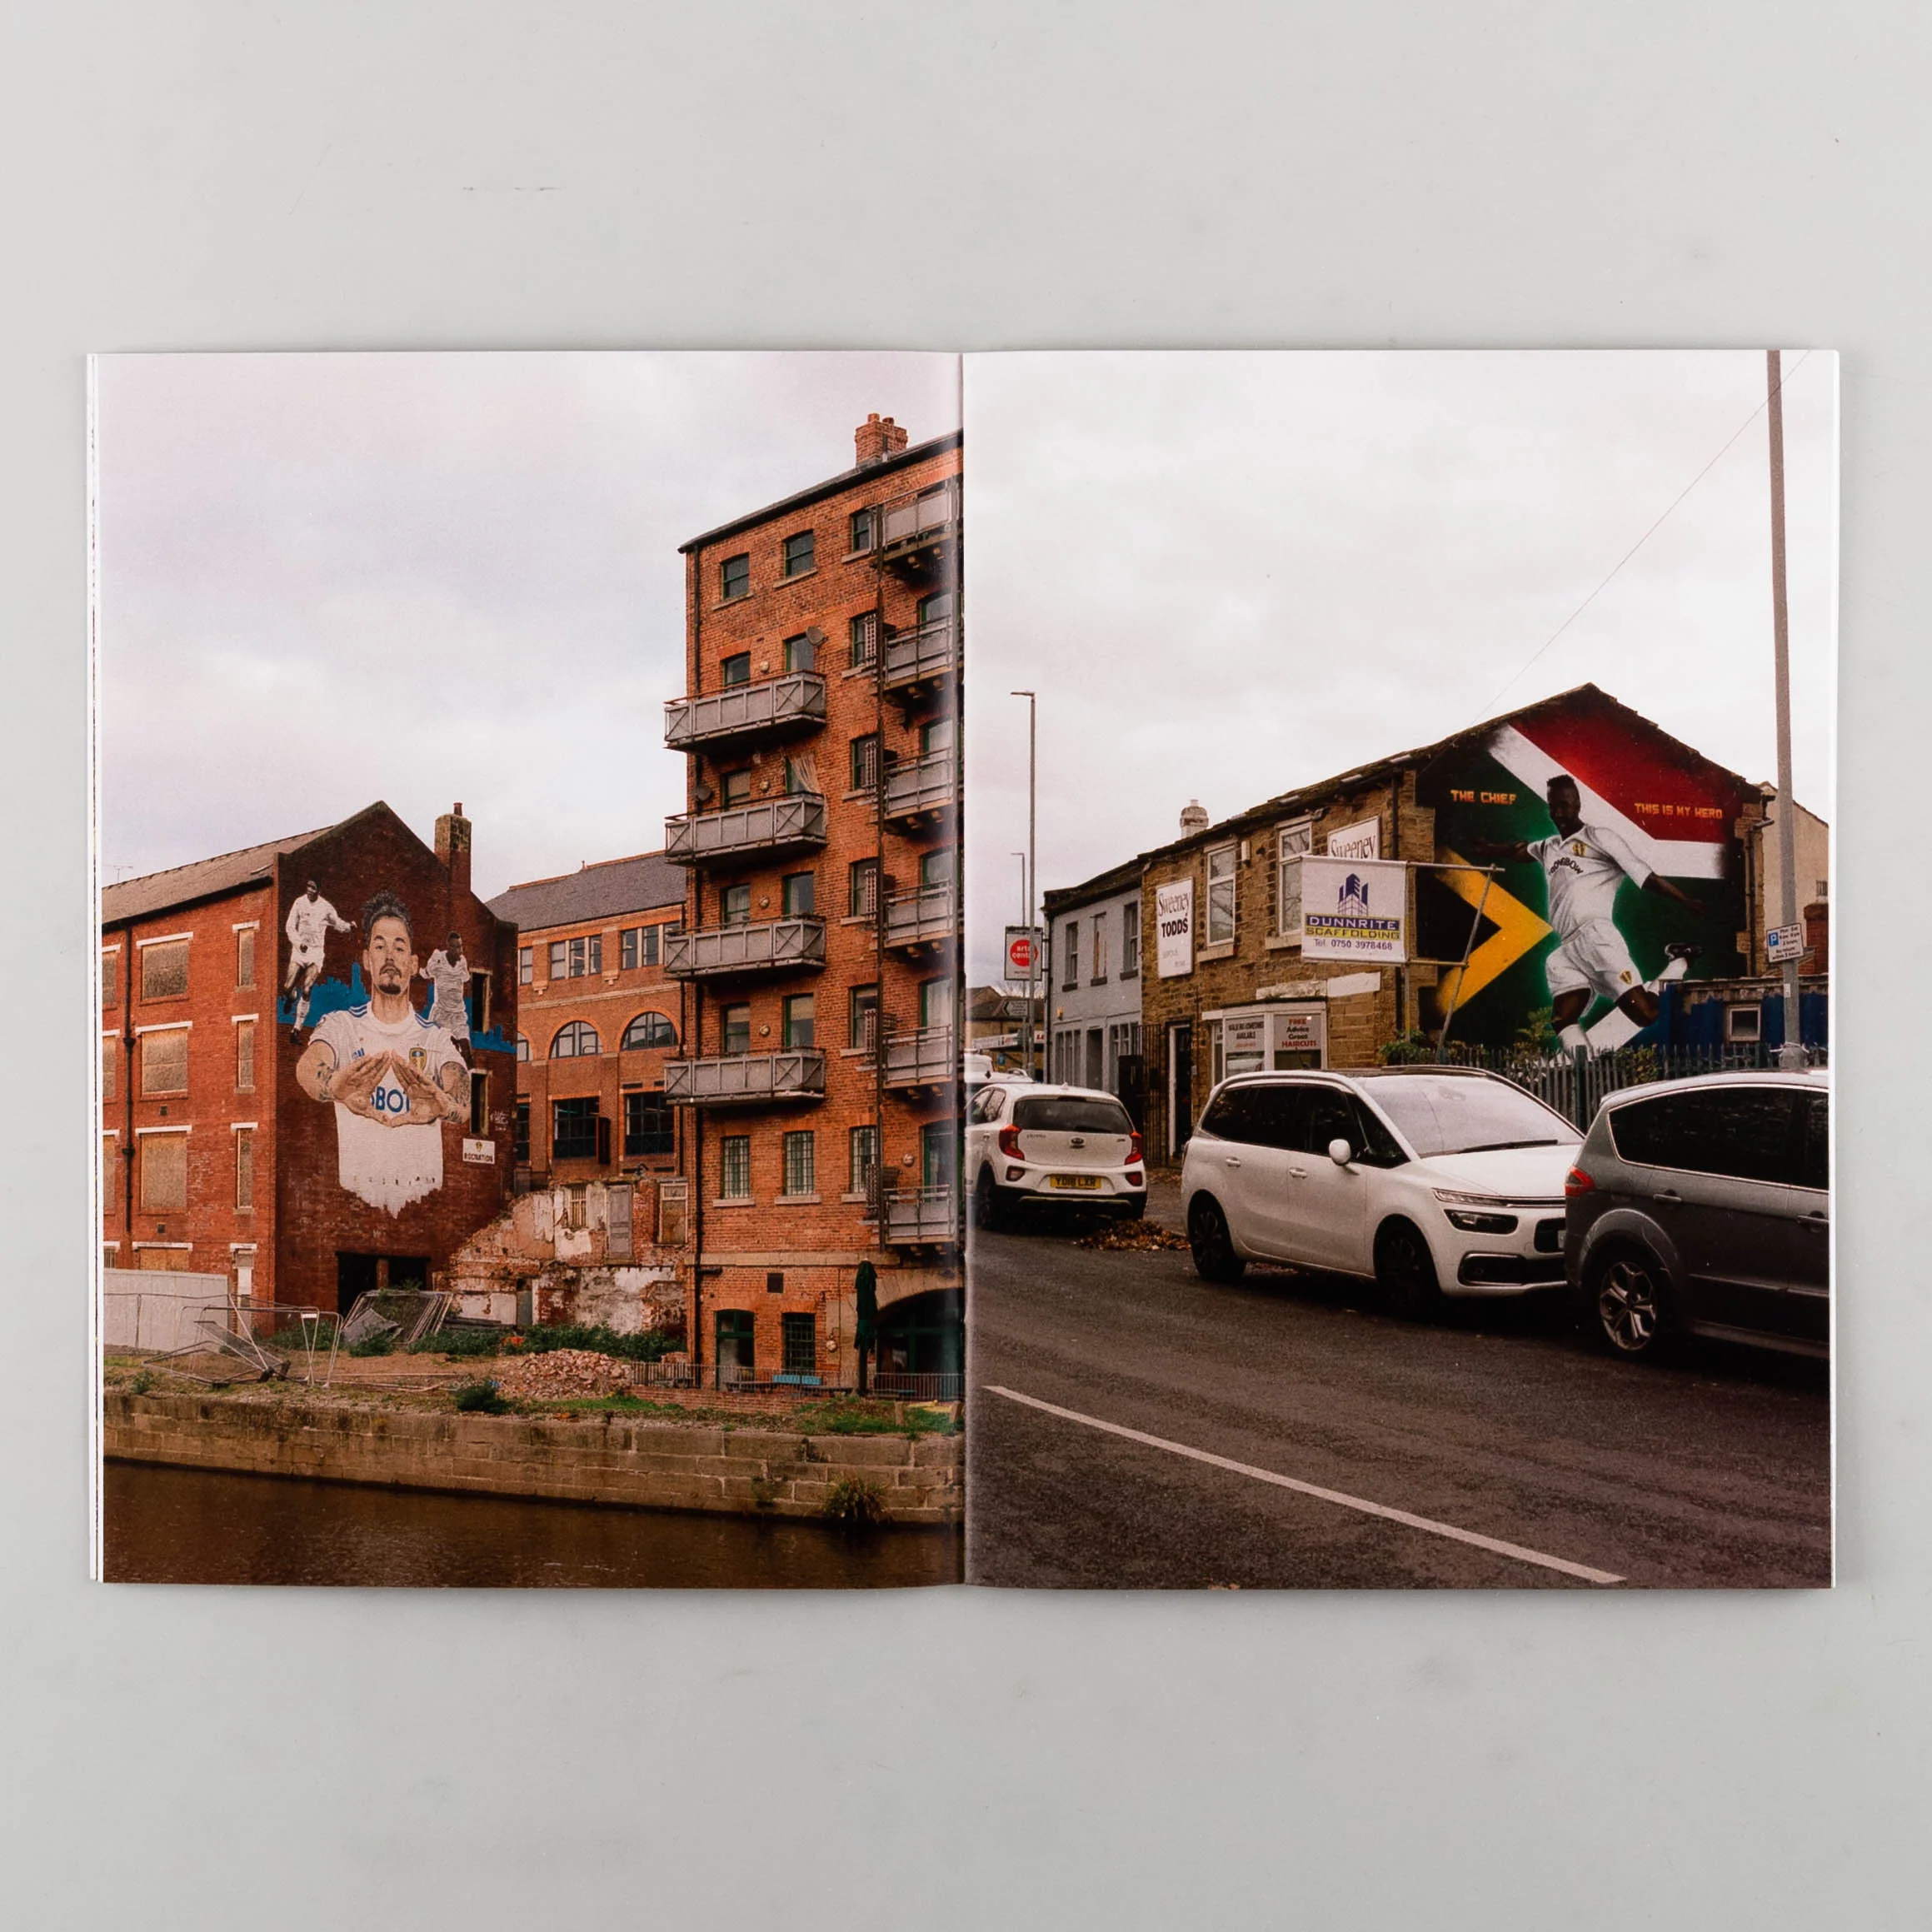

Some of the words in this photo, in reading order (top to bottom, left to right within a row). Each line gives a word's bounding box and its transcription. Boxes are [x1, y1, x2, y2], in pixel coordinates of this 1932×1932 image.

[1450, 790, 1475, 801] THE
[1480, 791, 1516, 805] CHIEF
[1634, 803, 1660, 815] THIS
[1662, 805, 1674, 816] IS
[1676, 806, 1690, 817] MY
[1695, 807, 1723, 819] HERO
[1331, 835, 1376, 859] Sweeney
[1159, 892, 1191, 916] Sweeney
[1309, 916, 1397, 930] DUNNRITE
[1305, 927, 1400, 940] SCAFFOLDING
[1331, 939, 1352, 948] 0750
[1355, 941, 1393, 951] 3978468
[371, 1086, 410, 1112] BO
